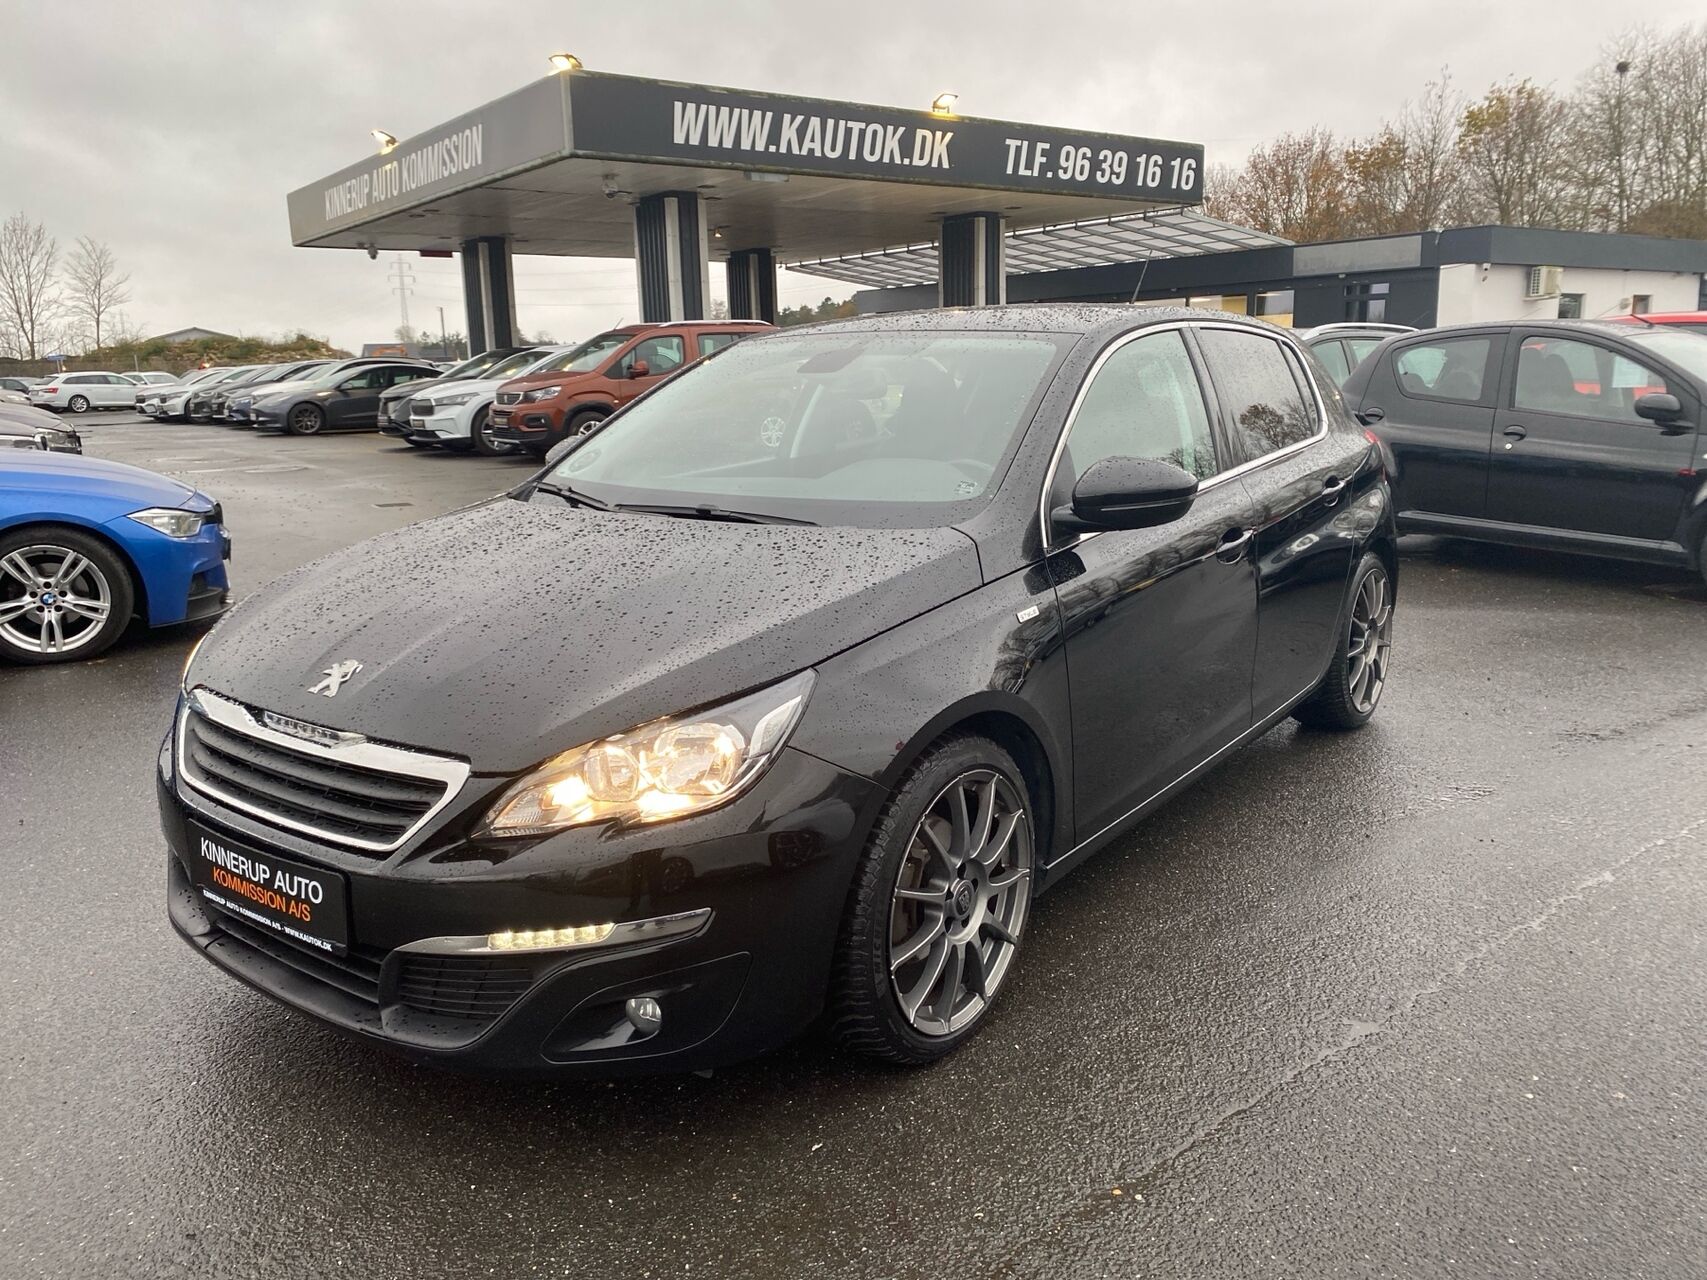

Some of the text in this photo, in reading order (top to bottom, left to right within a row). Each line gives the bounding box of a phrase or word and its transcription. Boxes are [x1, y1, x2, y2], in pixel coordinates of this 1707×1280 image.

[673, 100, 951, 170] WWW.KAUTOK.DK
[325, 124, 482, 221] KINNERUP AUTO KOMMISSION
[1005, 138, 1196, 190] TLF. 96 39 16 16
[272, 715, 332, 739] PEUGEOT
[201, 837, 323, 904] KINNERUP AUTO
[213, 866, 311, 922] KOMMISSION A/S
[226, 900, 239, 912] AUTO
